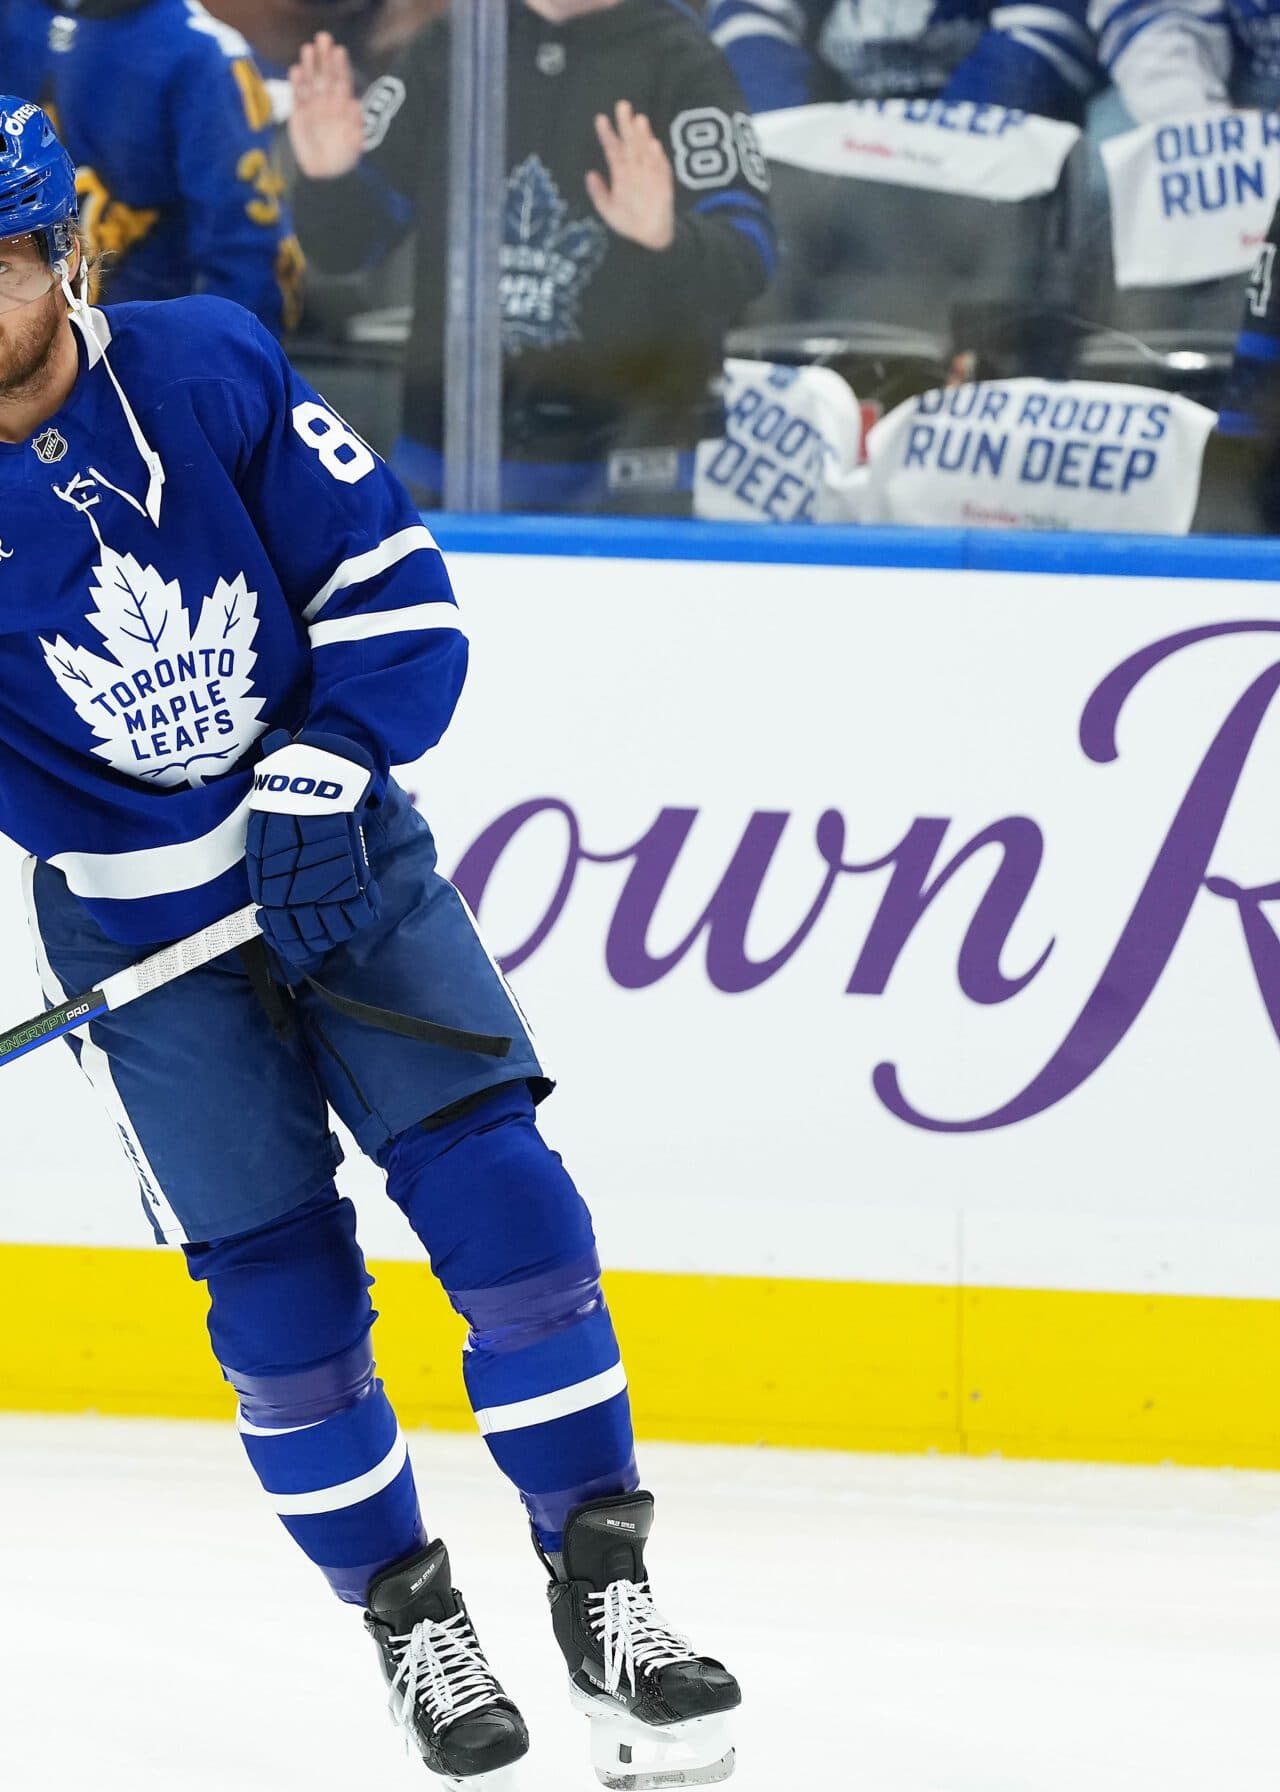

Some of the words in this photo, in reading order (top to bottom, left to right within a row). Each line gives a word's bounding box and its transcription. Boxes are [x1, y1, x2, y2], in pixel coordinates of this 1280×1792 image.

[1156, 115, 1245, 164] OUR
[1160, 160, 1265, 218] RUN
[292, 393, 385, 484] 8
[916, 384, 1008, 424] OUR
[1019, 393, 1170, 441] ROOTS
[904, 424, 1008, 477] RUN
[1020, 438, 1158, 492] DEEP
[90, 648, 235, 717] TORONTO
[123, 680, 226, 734] MAPLE
[131, 709, 234, 760] LEAFS
